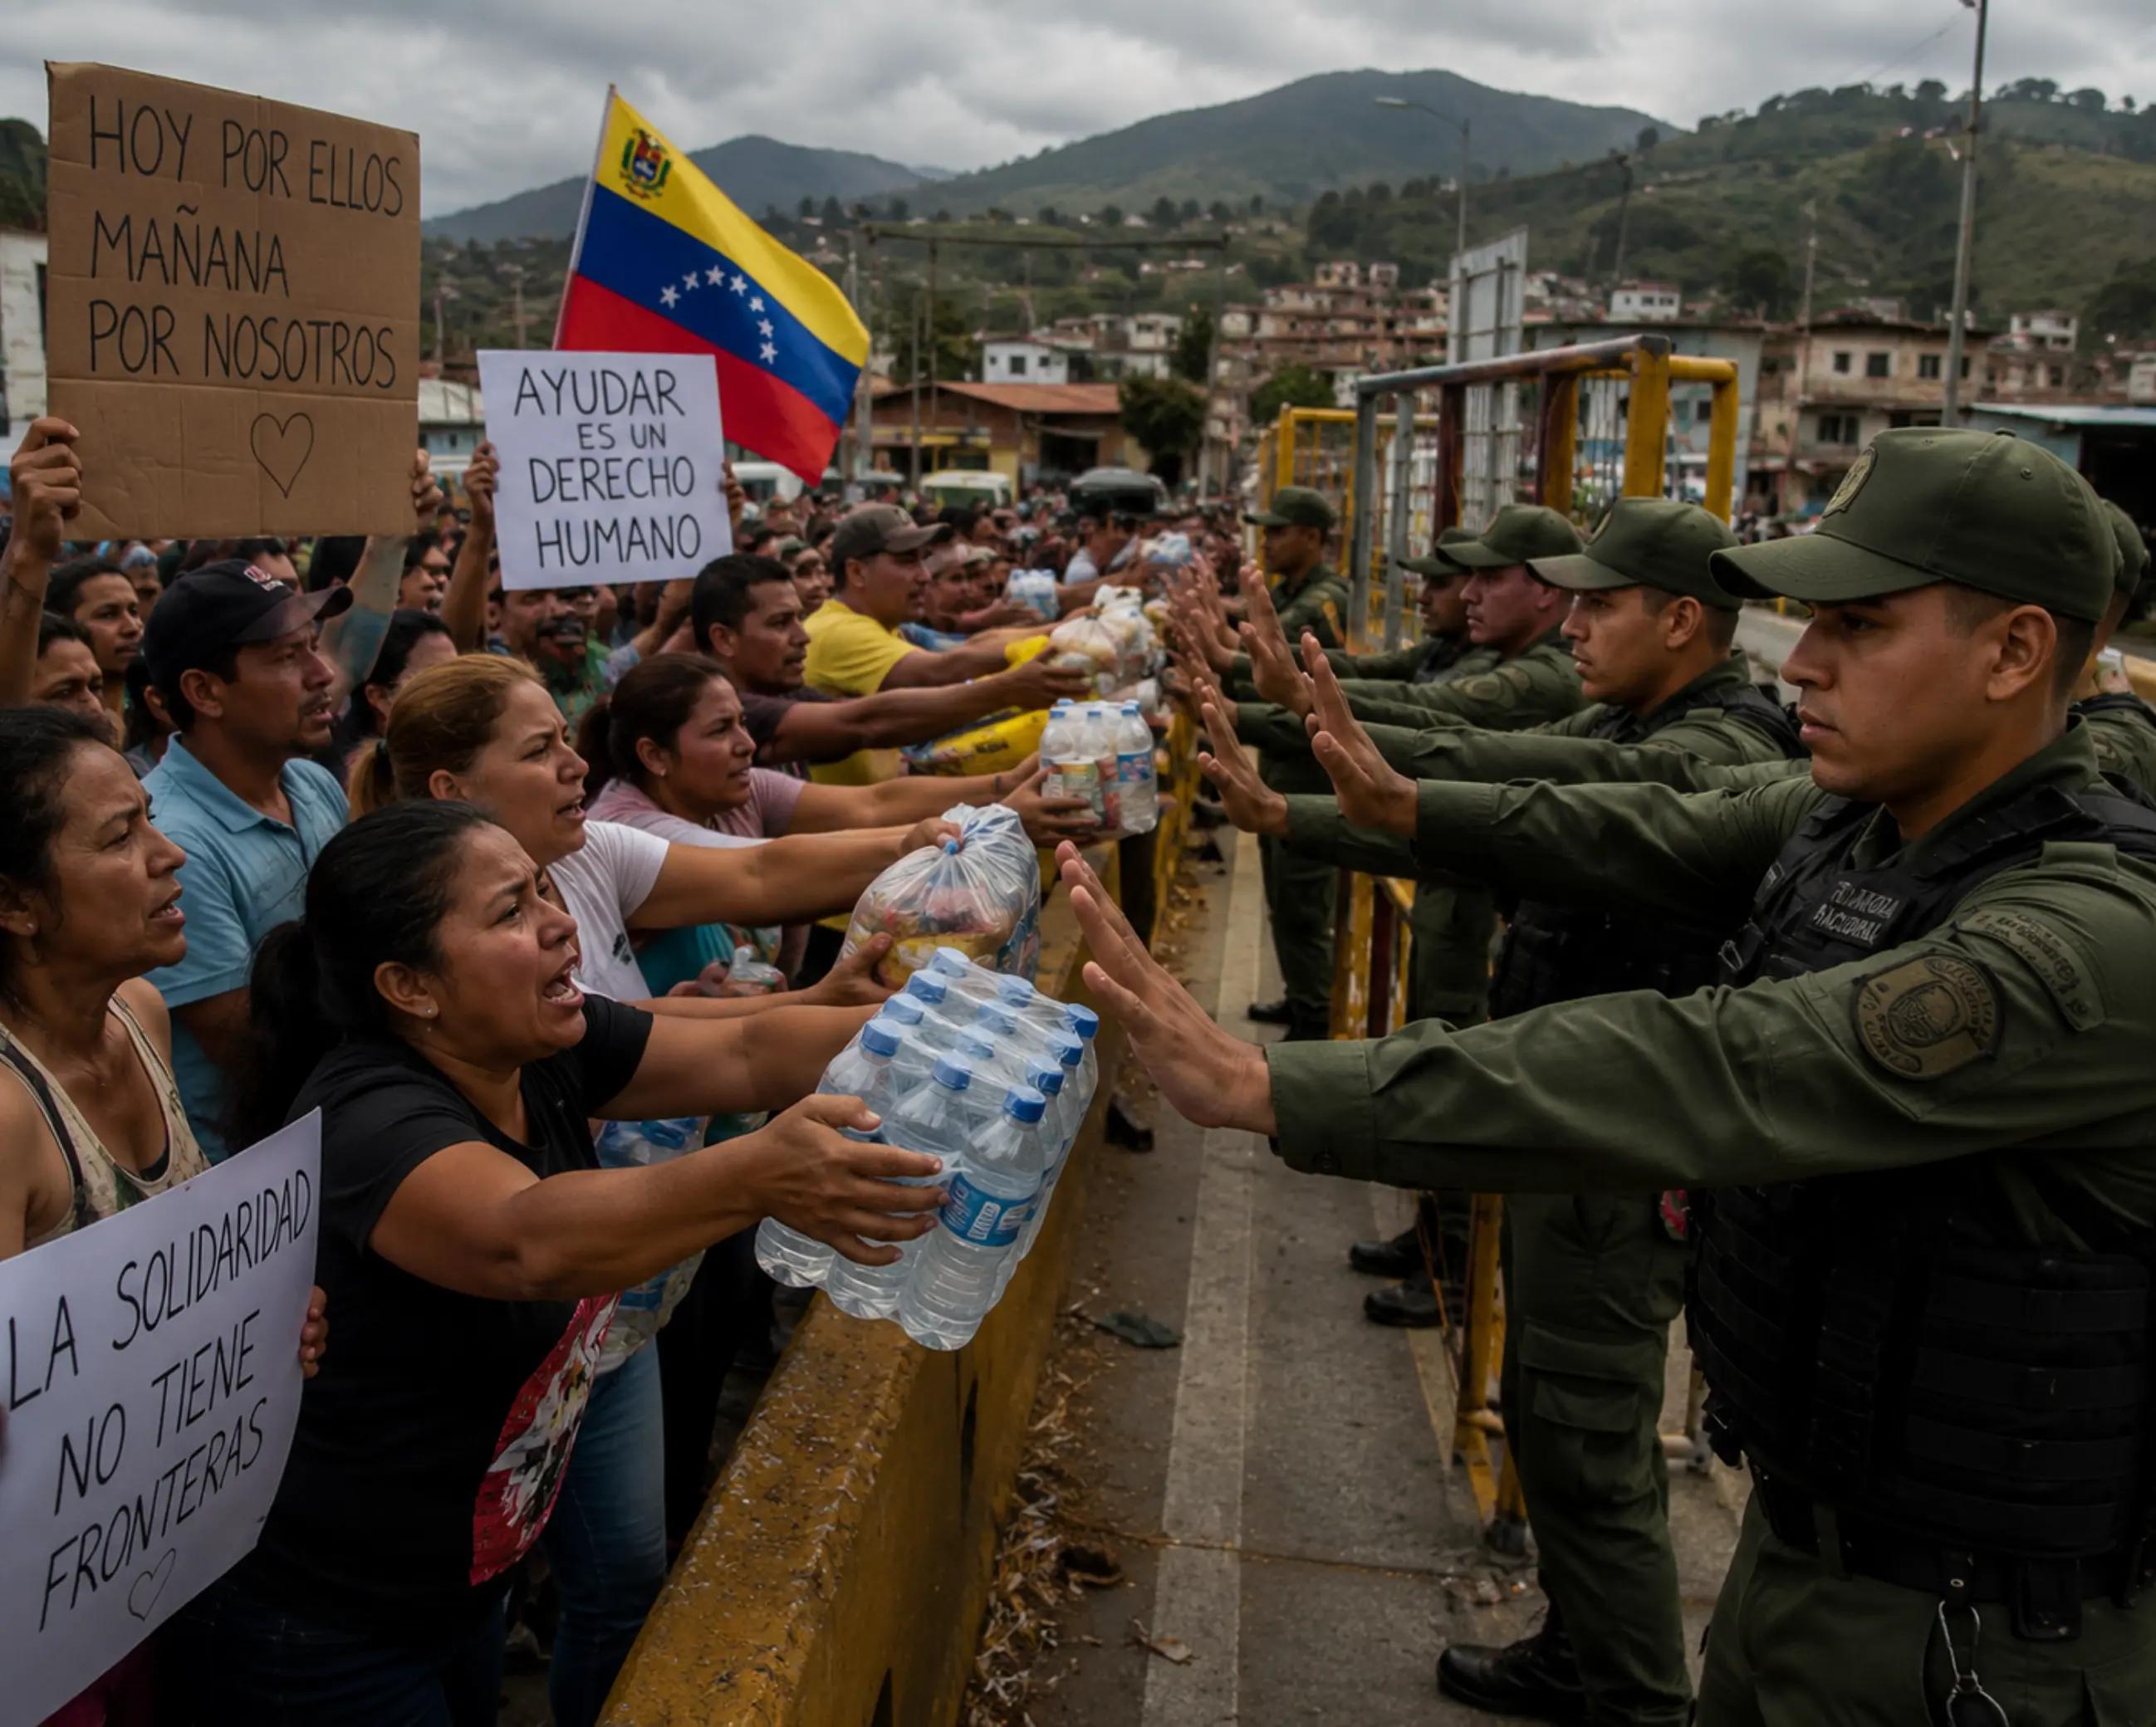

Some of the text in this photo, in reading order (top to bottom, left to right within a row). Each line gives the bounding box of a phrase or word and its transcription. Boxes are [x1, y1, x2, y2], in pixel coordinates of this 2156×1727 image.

[91, 95, 402, 217] HOY POR ELLOS
[91, 204, 289, 297] MAÑANA
[89, 299, 395, 389] POR NOSOTROS
[515, 368, 684, 416] AYUDAR
[577, 423, 665, 450] ES UN
[529, 456, 694, 503] DERECHO
[536, 514, 701, 568] HUMANO
[9, 1169, 311, 1411] LA SOLIDARIDAD
[54, 1309, 260, 1516] NO TIENE
[39, 1397, 267, 1632] FRONTERAS
